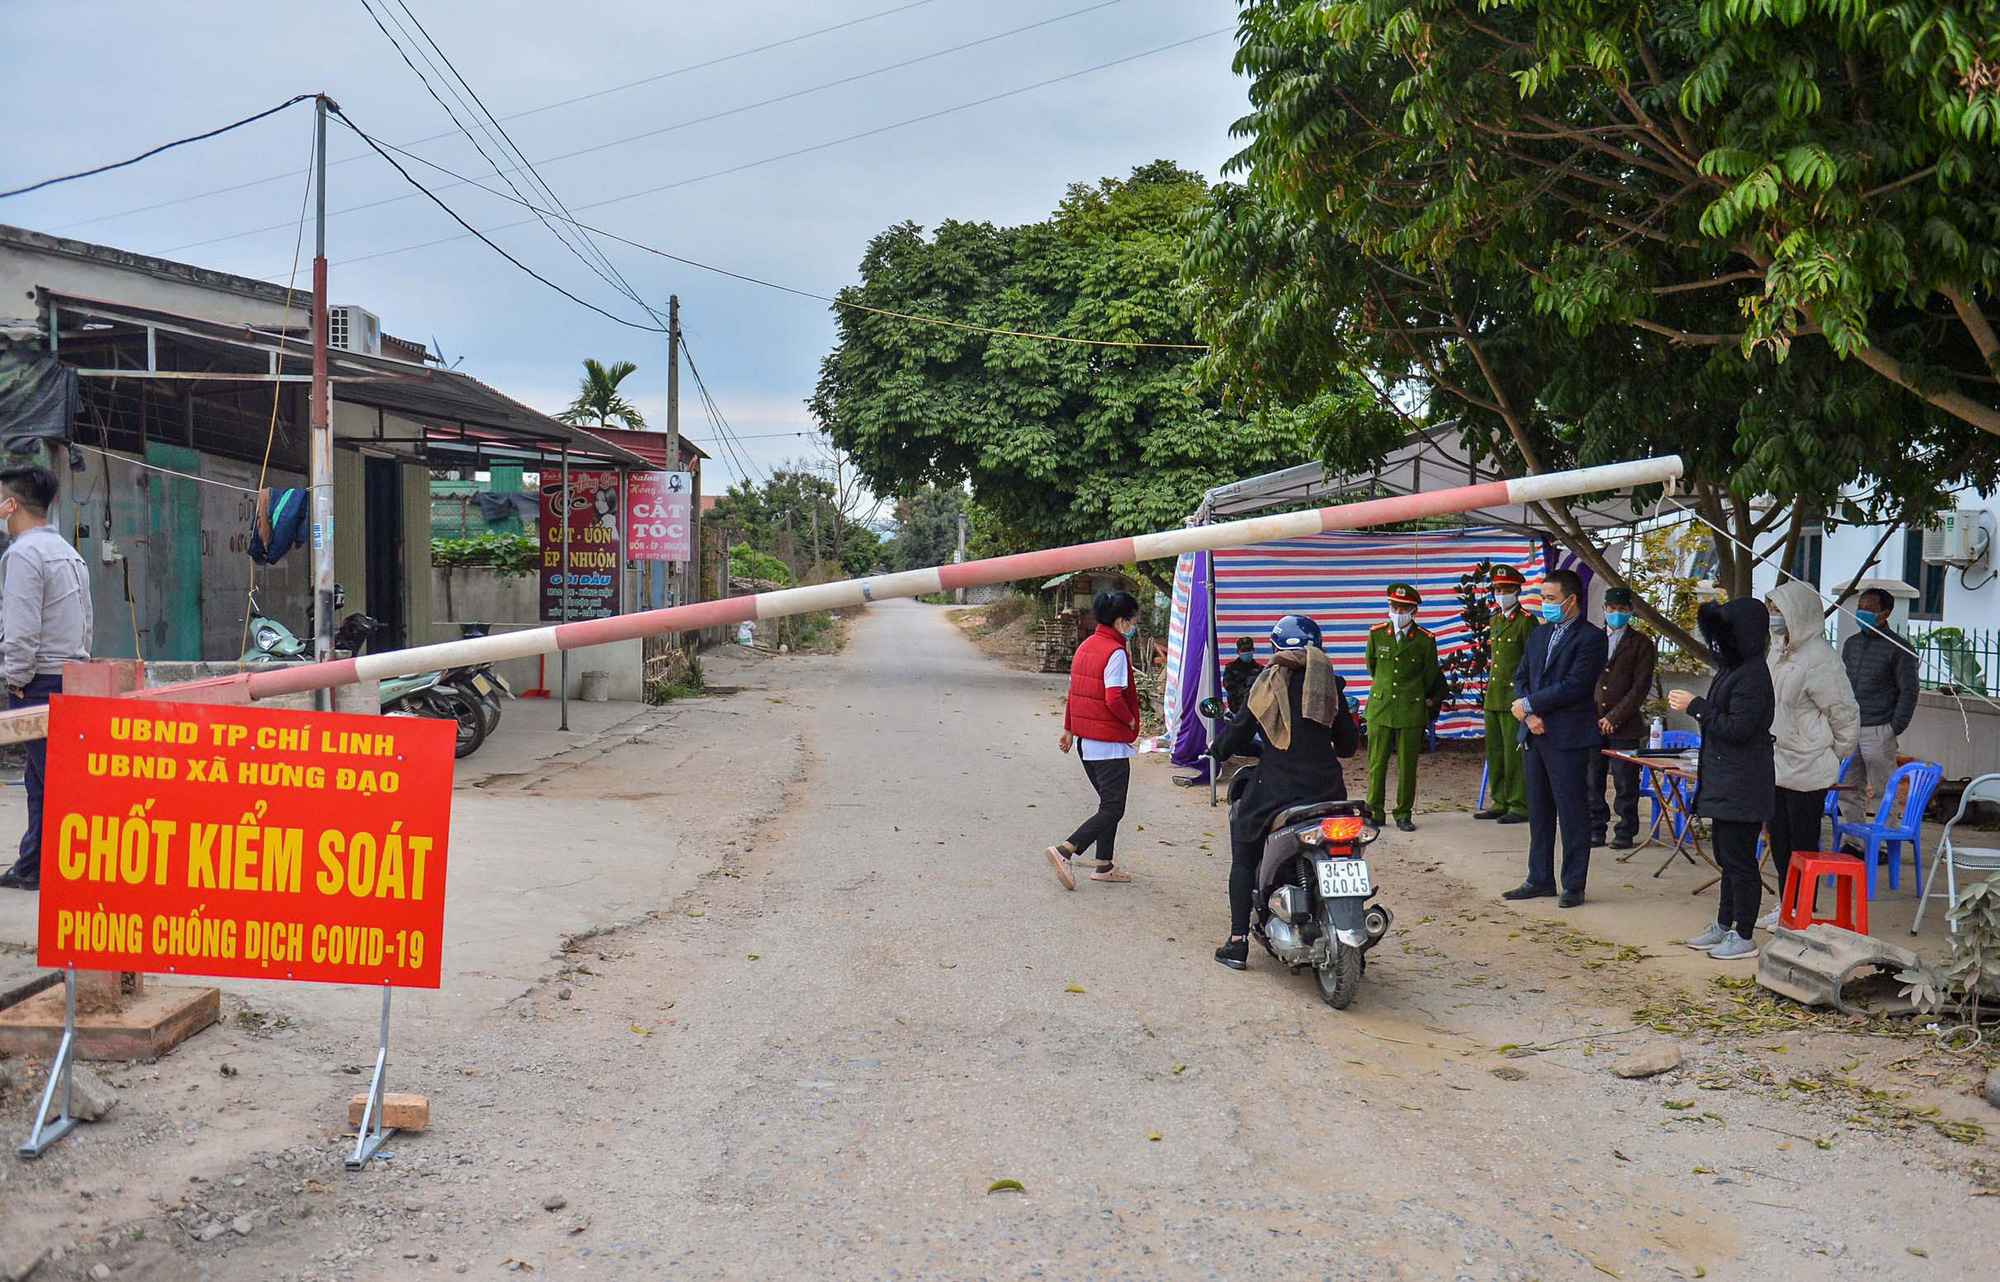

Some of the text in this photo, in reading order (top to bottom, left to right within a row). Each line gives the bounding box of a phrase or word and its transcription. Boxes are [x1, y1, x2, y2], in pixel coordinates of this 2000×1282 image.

[630, 473, 660, 482] Salon
[633, 496, 685, 518] CẮT
[584, 520, 612, 544] UỐN
[633, 520, 684, 538] TÓC
[543, 546, 617, 572] ÉP NHUỘM
[110, 717, 395, 757] UBND TP CHÍ LINH
[87, 753, 400, 797] UBND XÃ HƯNG ĐẠO
[58, 799, 434, 900] CHỐT KIỂM SOÁT
[1324, 862, 1361, 878] 34-C1
[1322, 878, 1369, 895] 340.45
[57, 903, 425, 970] PHÒNG CHỐNG DỊCH COVID-19
